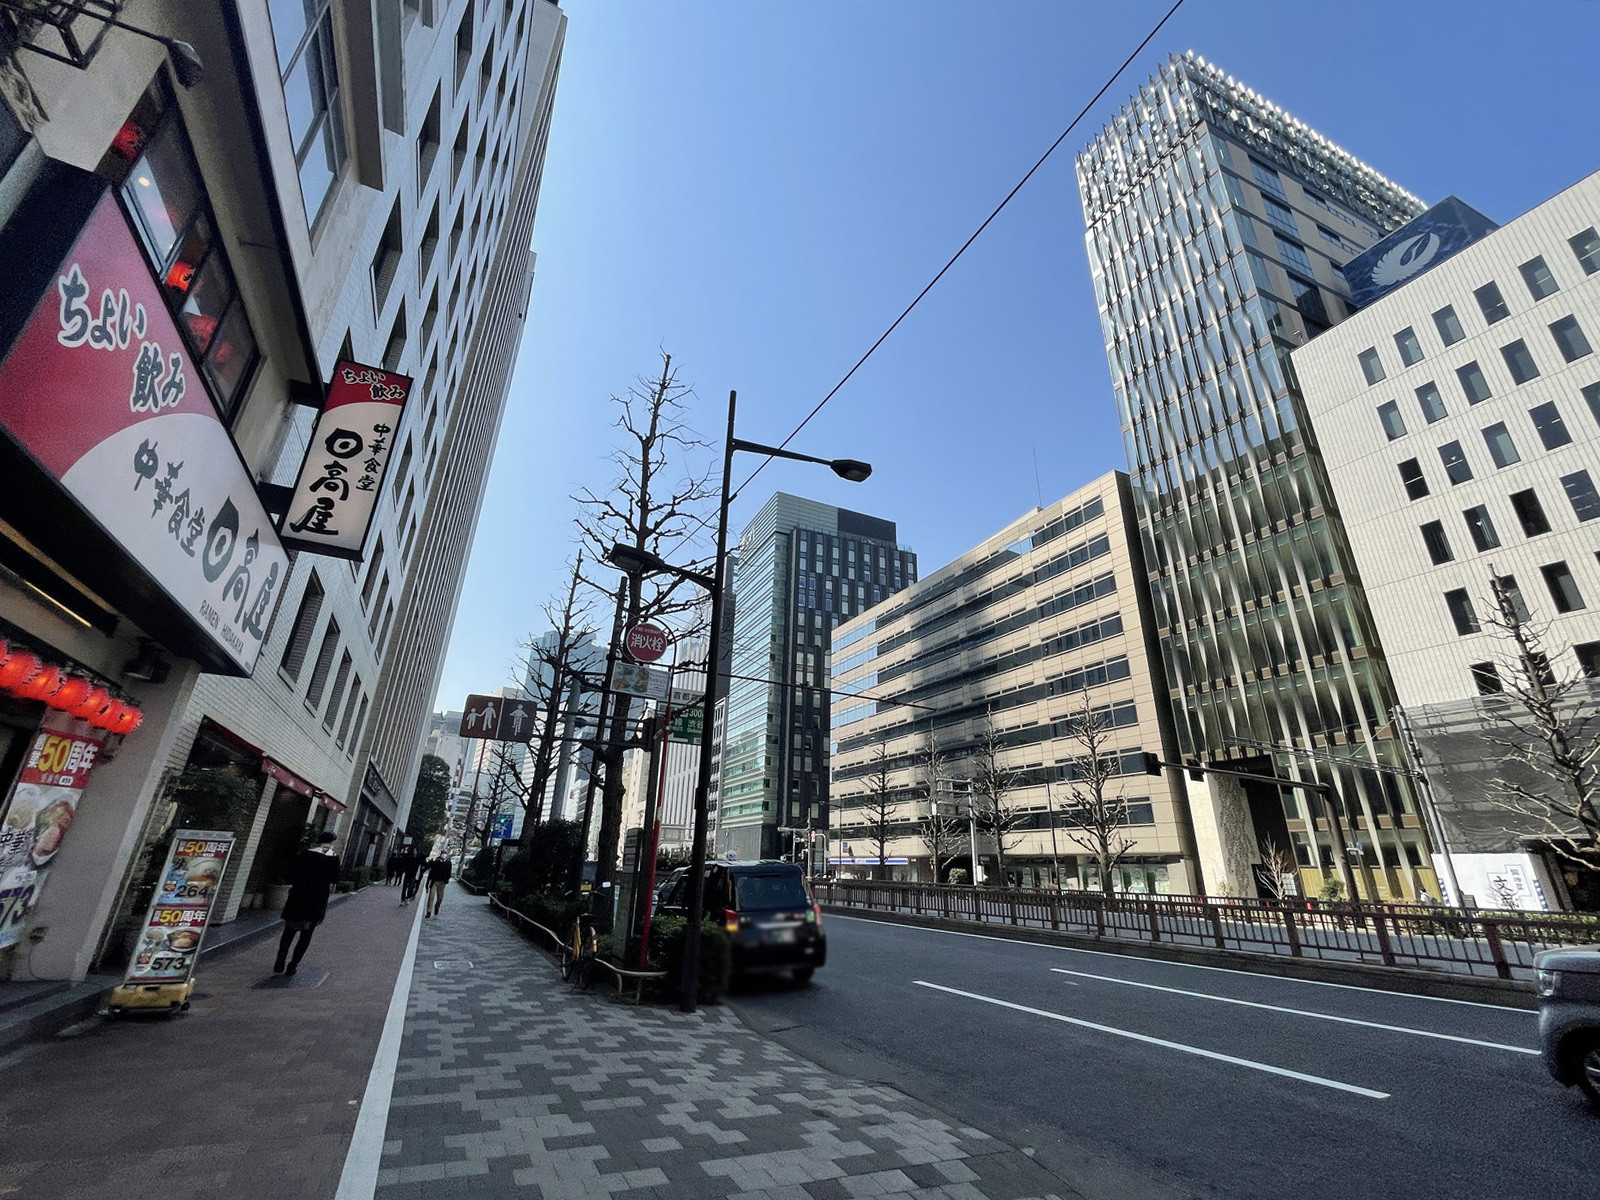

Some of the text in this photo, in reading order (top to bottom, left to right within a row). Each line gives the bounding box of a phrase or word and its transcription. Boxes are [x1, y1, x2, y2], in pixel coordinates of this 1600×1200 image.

[59, 264, 147, 350] ちょい
[131, 342, 185, 412] 飲み
[342, 369, 385, 384] ちょい
[370, 383, 405, 400] 飲み
[356, 423, 391, 491] 中華食堂
[289, 427, 364, 535] 日高屋
[199, 599, 220, 630] RAMEN
[630, 632, 664, 652] 消火栓
[689, 707, 703, 718] 300
[174, 886, 208, 898] 264
[151, 957, 185, 970] 573
